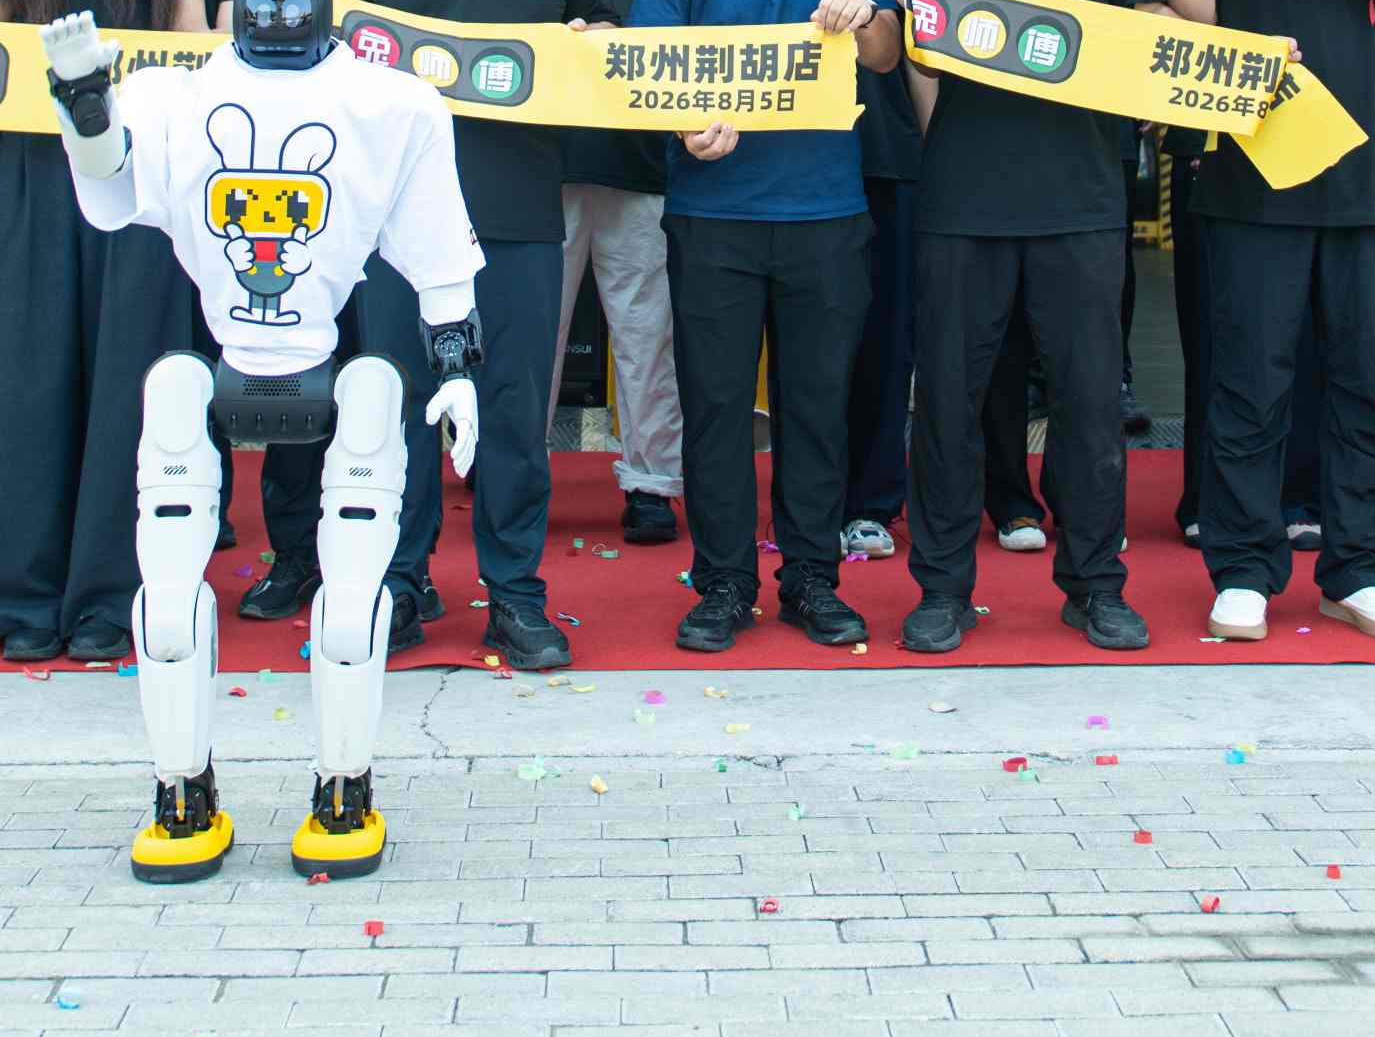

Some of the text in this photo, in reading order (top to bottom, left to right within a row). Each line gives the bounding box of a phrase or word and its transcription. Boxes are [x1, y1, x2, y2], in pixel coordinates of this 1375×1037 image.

[604, 41, 822, 83] 郑州荆胡店
[1152, 35, 1282, 94] 郑州荆
[628, 89, 796, 113] 2026年8月5日
[1168, 87, 1269, 119] 2026年8
